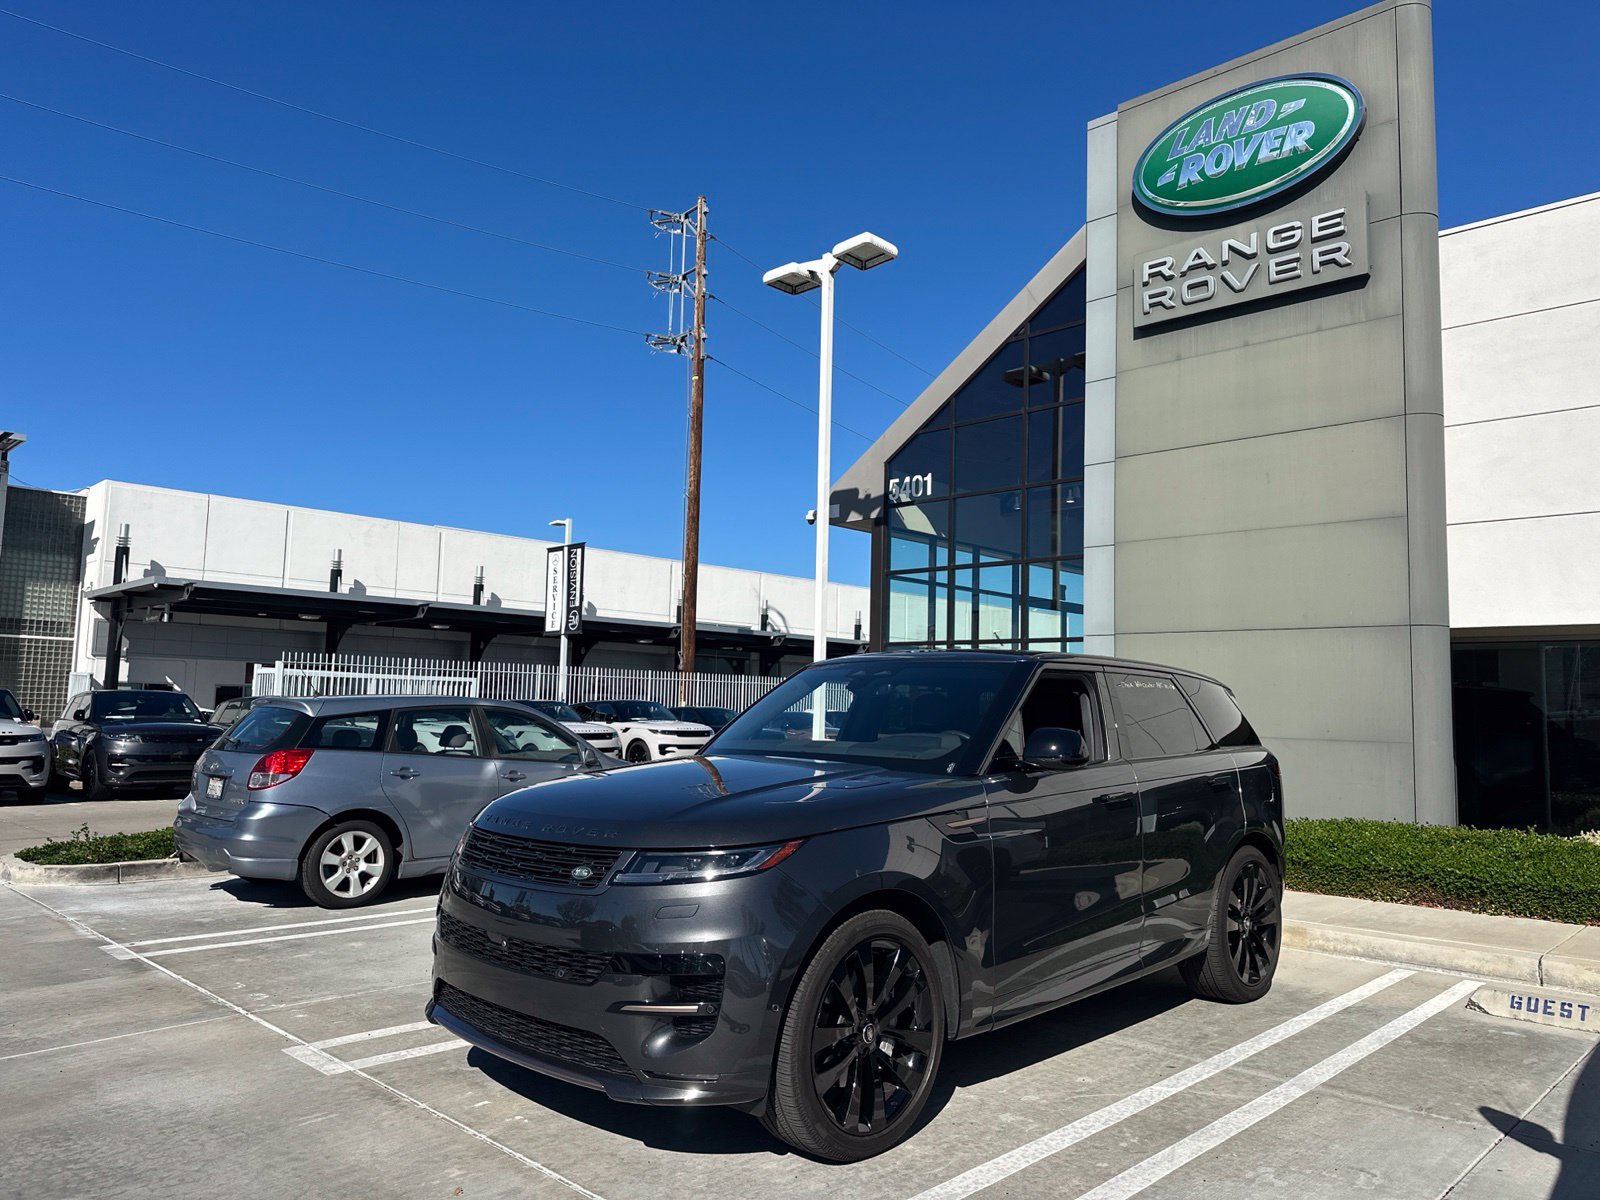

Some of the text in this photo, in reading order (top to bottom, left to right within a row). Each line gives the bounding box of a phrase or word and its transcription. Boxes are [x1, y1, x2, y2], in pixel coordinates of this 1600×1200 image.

[1167, 98, 1277, 160] LAND
[1177, 121, 1314, 191] ROVER
[1142, 207, 1346, 286] RANGE
[1142, 242, 1353, 314] ROVER
[889, 472, 932, 501] 5401
[569, 548, 577, 607] ENVISION
[541, 823, 618, 839] ROVER
[1510, 995, 1590, 1021] GUEST
